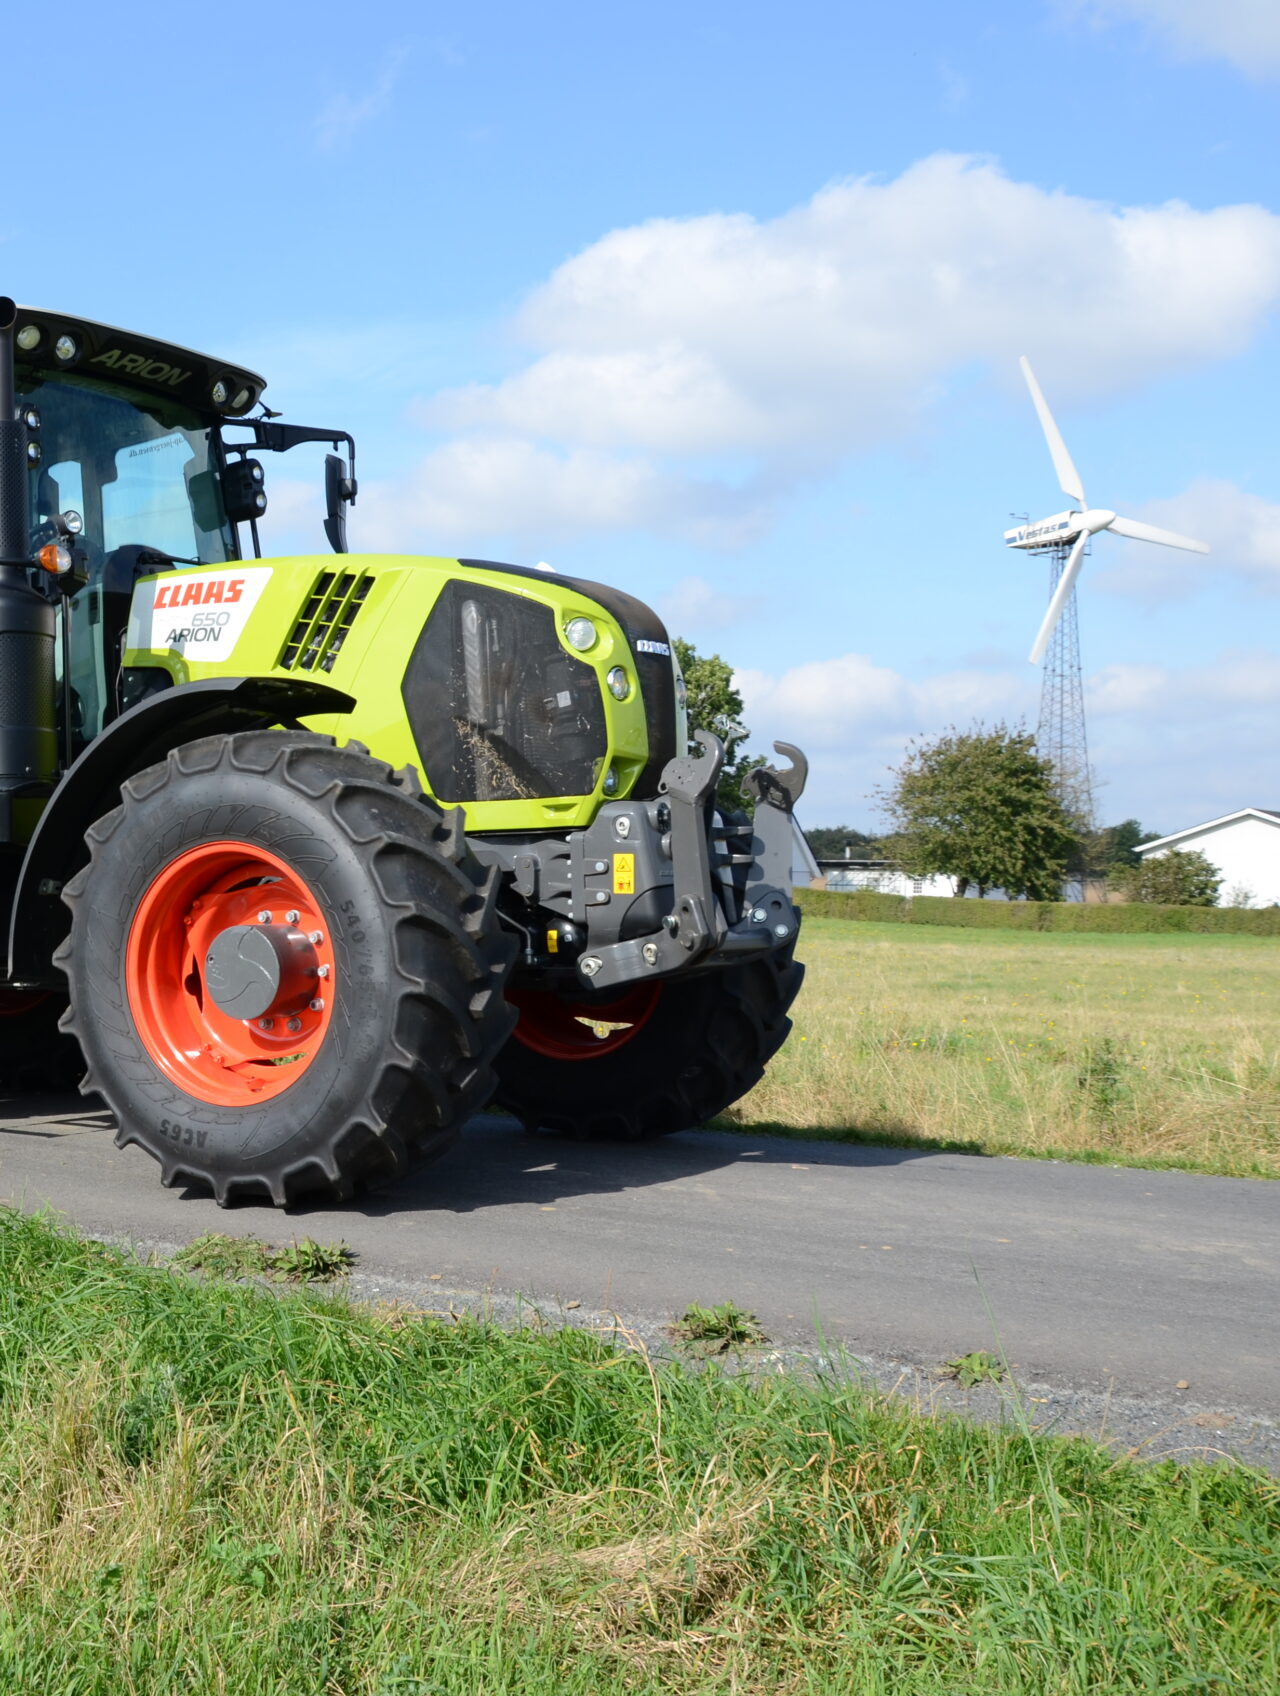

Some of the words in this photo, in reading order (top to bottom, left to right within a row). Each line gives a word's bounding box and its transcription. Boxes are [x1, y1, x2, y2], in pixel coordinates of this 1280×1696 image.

[90, 348, 192, 385] ARION
[1018, 524, 1058, 541] Vestas
[152, 579, 245, 610] CLAAS
[191, 611, 230, 628] 650
[165, 627, 222, 643] ARION
[160, 1118, 209, 1149] AC65
